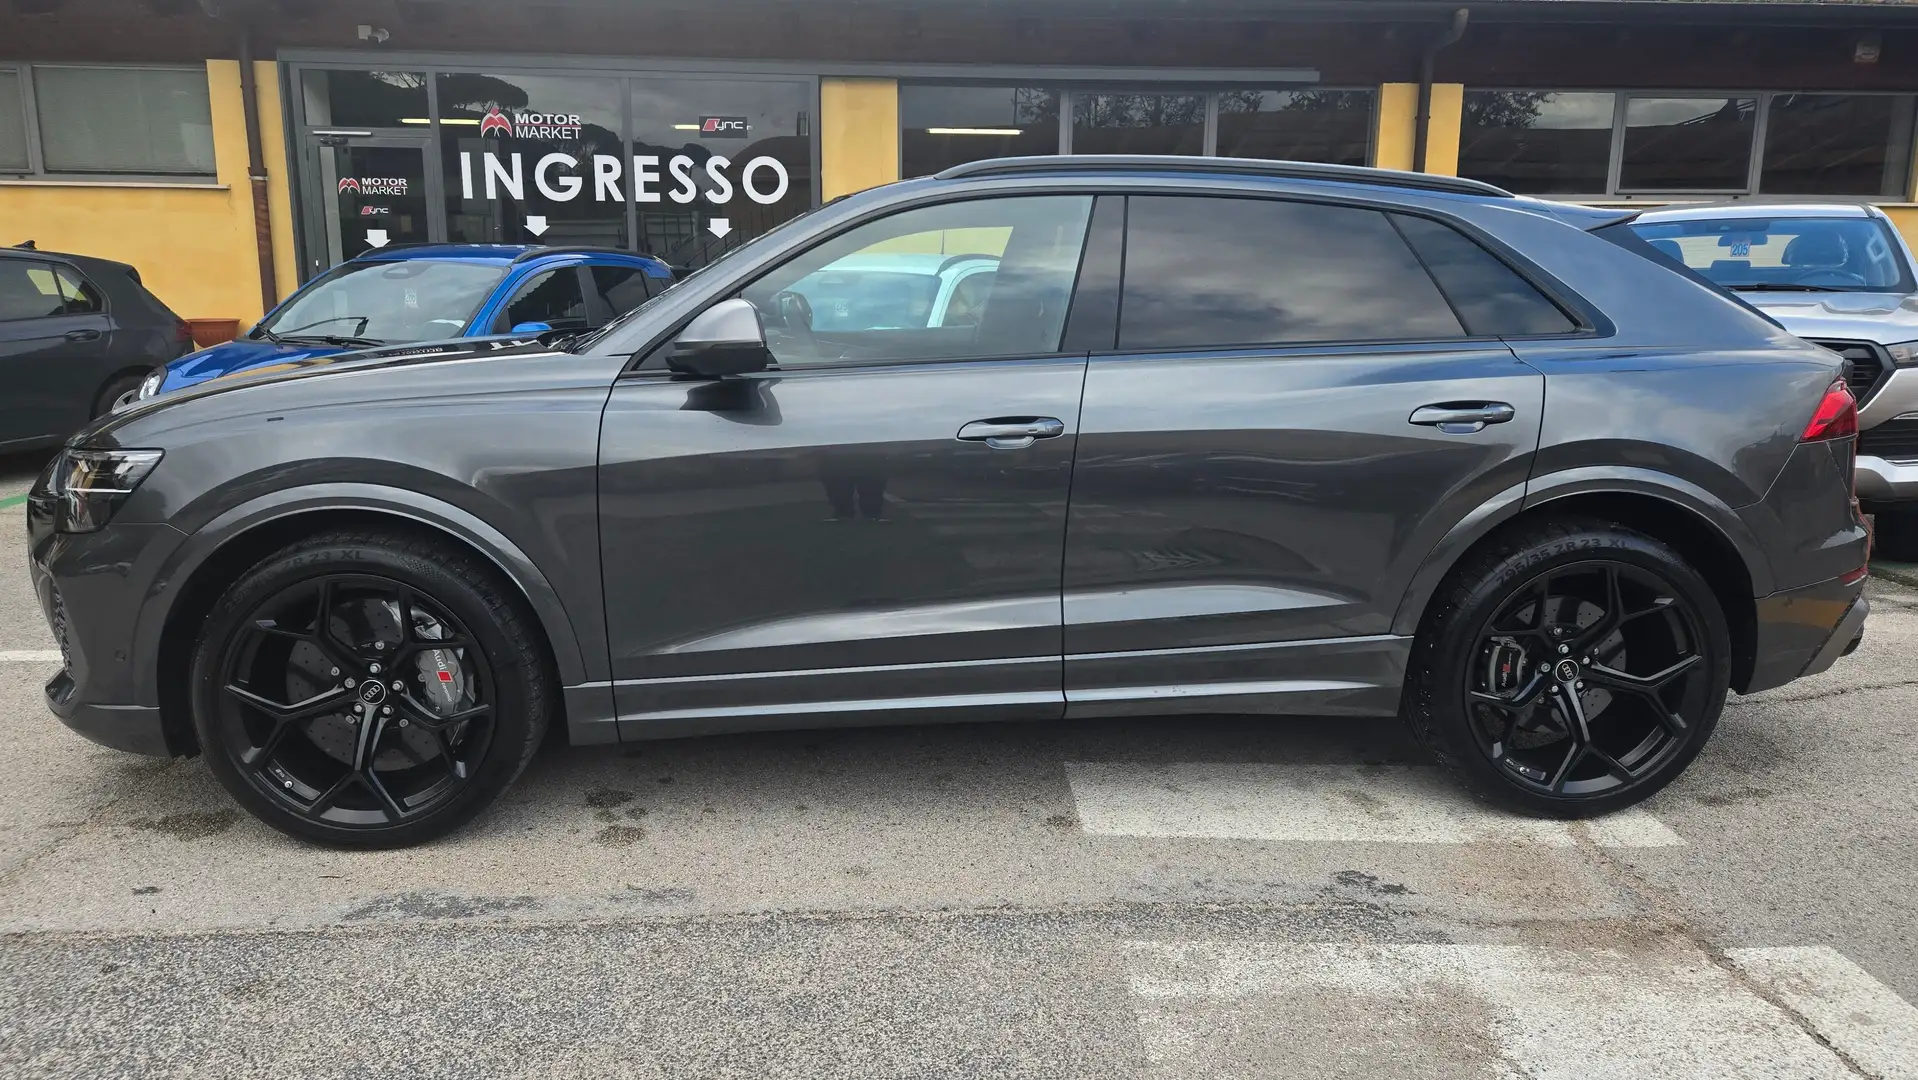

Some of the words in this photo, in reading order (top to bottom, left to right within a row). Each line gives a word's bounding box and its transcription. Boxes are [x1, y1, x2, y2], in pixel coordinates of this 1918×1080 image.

[514, 113, 581, 125] MOTOR
[515, 126, 582, 140] MARKET
[361, 177, 407, 187] MOTOR
[460, 151, 789, 205] INGRESSO
[362, 186, 408, 196] MARKET
[1732, 243, 1748, 256] 205
[1581, 538, 1602, 549] 23
[309, 551, 333, 563] 23
[340, 549, 366, 561] XL
[432, 649, 447, 671] Audi
